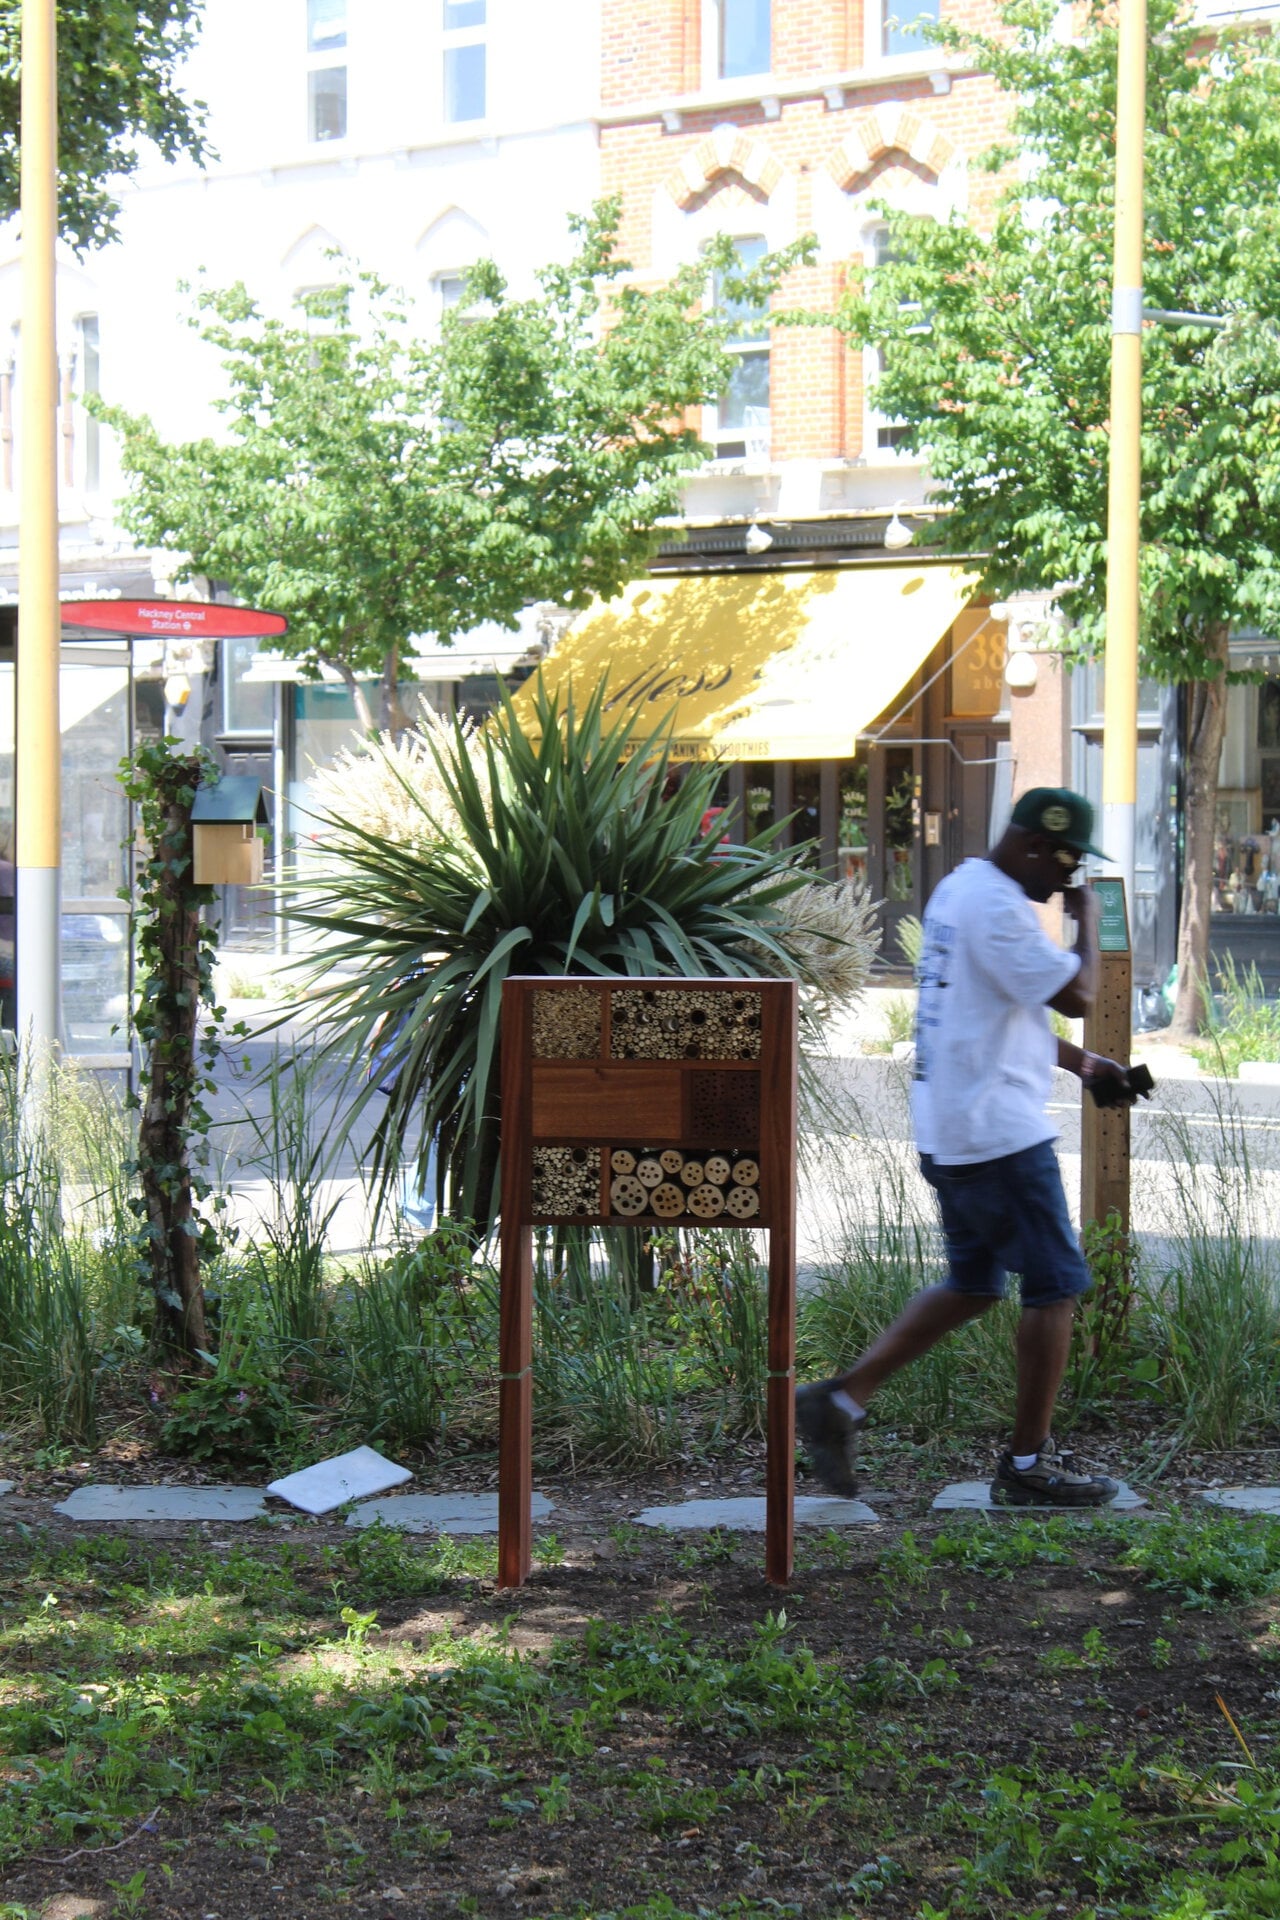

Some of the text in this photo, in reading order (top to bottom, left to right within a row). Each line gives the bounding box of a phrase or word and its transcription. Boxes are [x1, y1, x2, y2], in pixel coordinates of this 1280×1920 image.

[138, 607, 206, 621] Hackney Central
[152, 619, 181, 629] Station
[968, 633, 1008, 671] 38
[712, 742, 769, 757] SMOOTHIES
